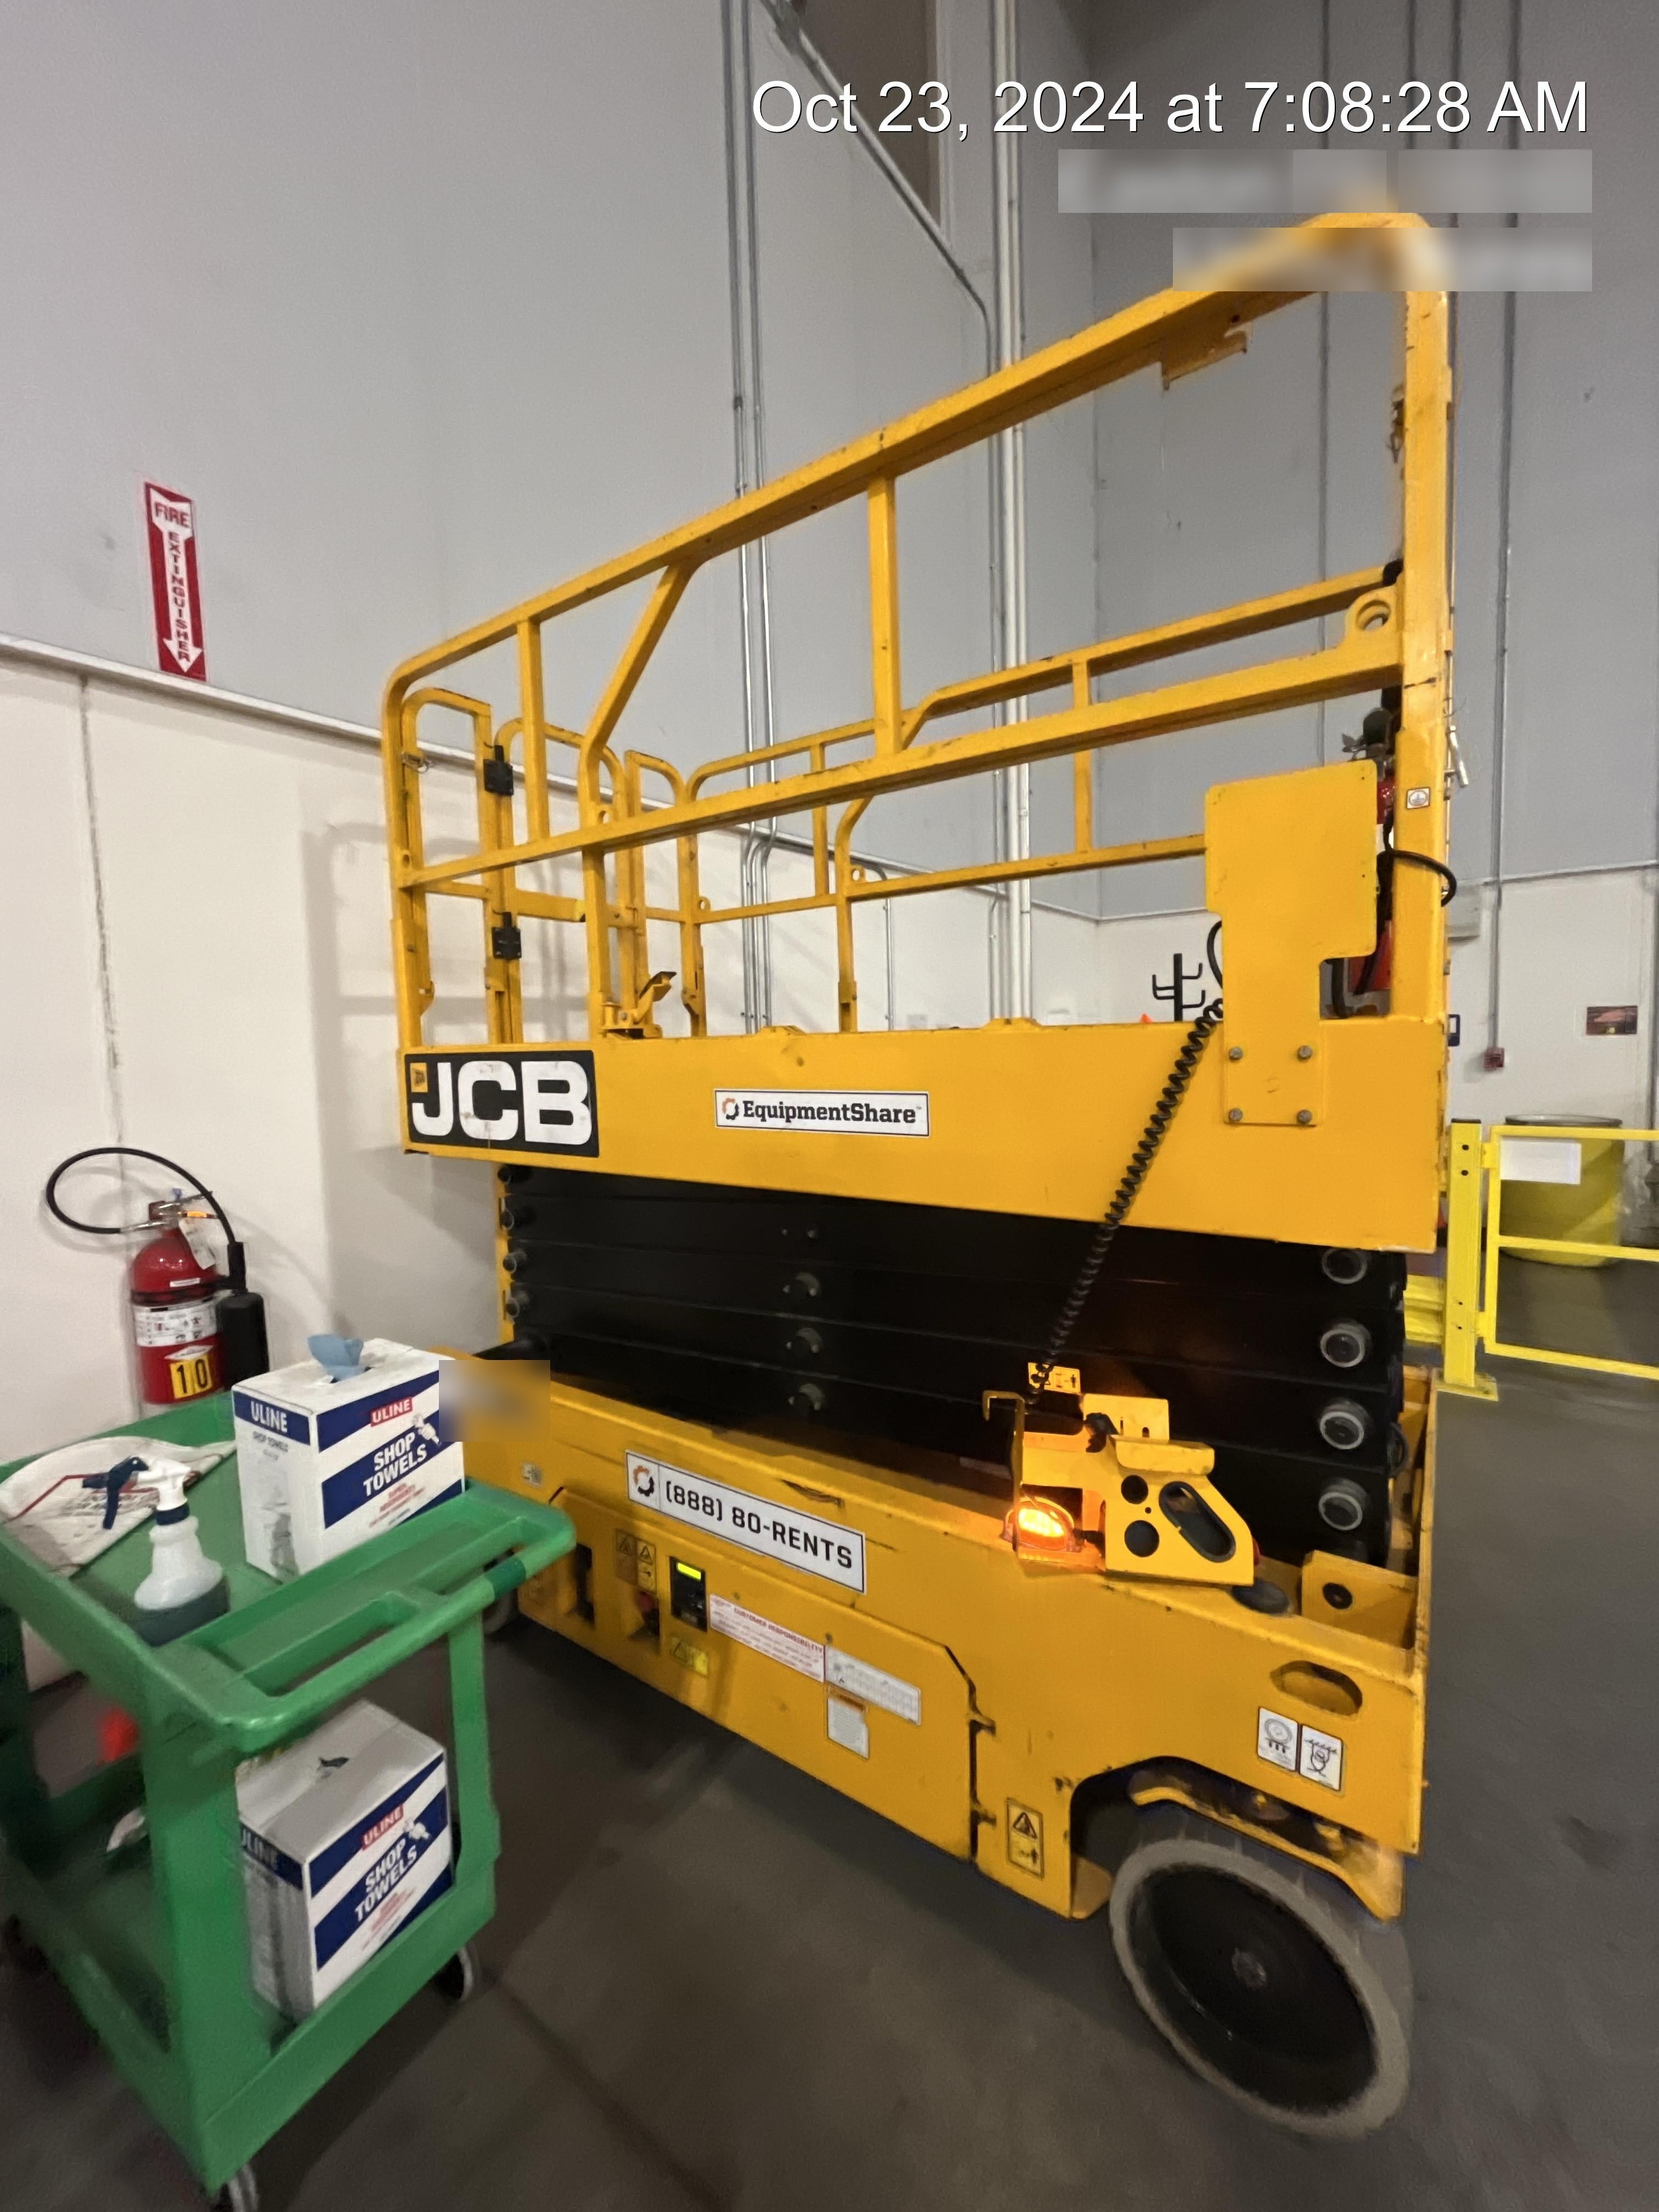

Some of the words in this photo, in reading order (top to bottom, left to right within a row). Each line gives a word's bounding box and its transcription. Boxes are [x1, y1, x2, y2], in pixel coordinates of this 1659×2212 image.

[155, 503, 190, 528] FIRE
[168, 531, 190, 663] EXTINGUISHER
[411, 1059, 592, 1146] JCB
[742, 1099, 917, 1124] EquipmentShare
[177, 1358, 208, 1395] 10
[250, 1400, 288, 1434] ULINE
[372, 1398, 411, 1423] ULINE
[363, 1443, 427, 1497] TOWELS
[374, 1431, 416, 1471] SHOP
[665, 1479, 723, 1522] (888)
[731, 1505, 853, 1570] 80-RENTS
[364, 1805, 403, 1845] ULINE
[354, 1844, 417, 1922] TOWELS
[364, 1838, 406, 1892] SHOP
